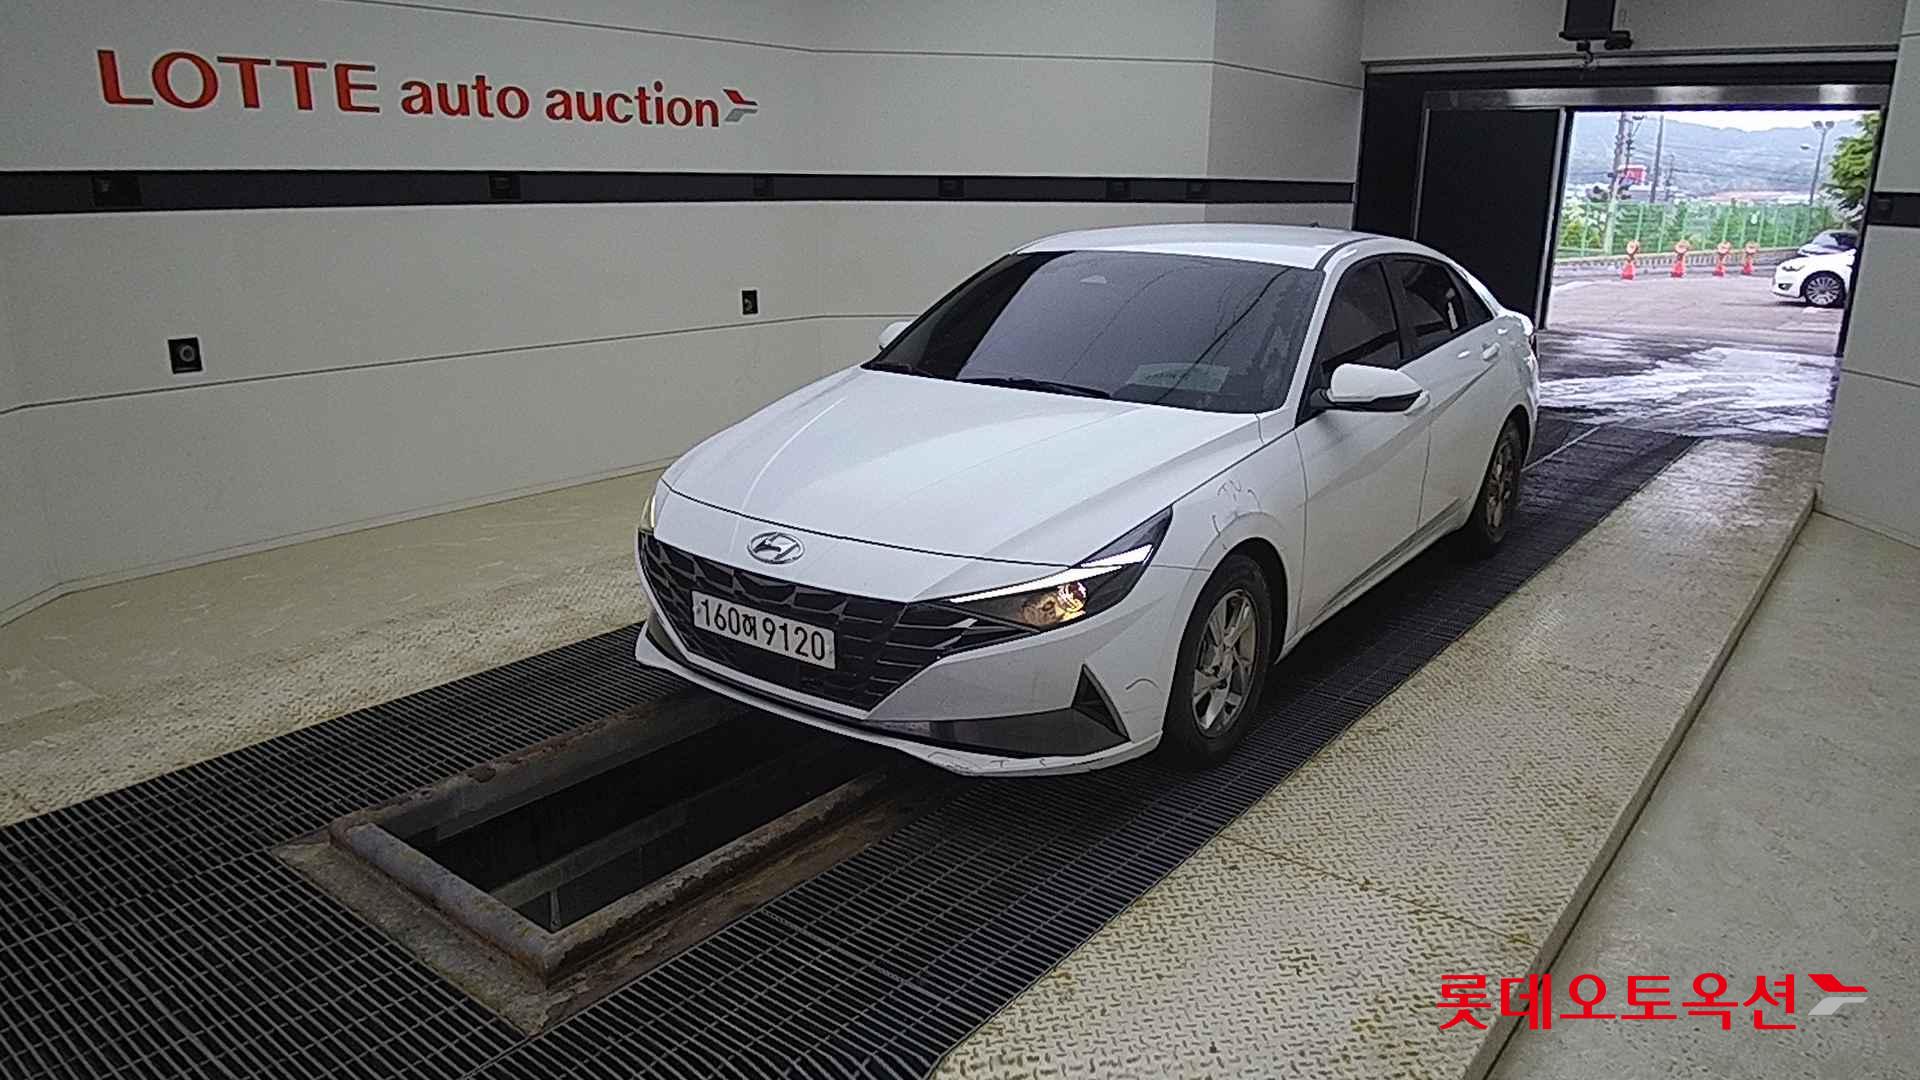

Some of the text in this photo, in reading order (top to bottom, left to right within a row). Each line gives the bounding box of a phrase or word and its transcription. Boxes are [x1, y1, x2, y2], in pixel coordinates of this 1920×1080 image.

[97, 49, 720, 127] LOTTE auto auction
